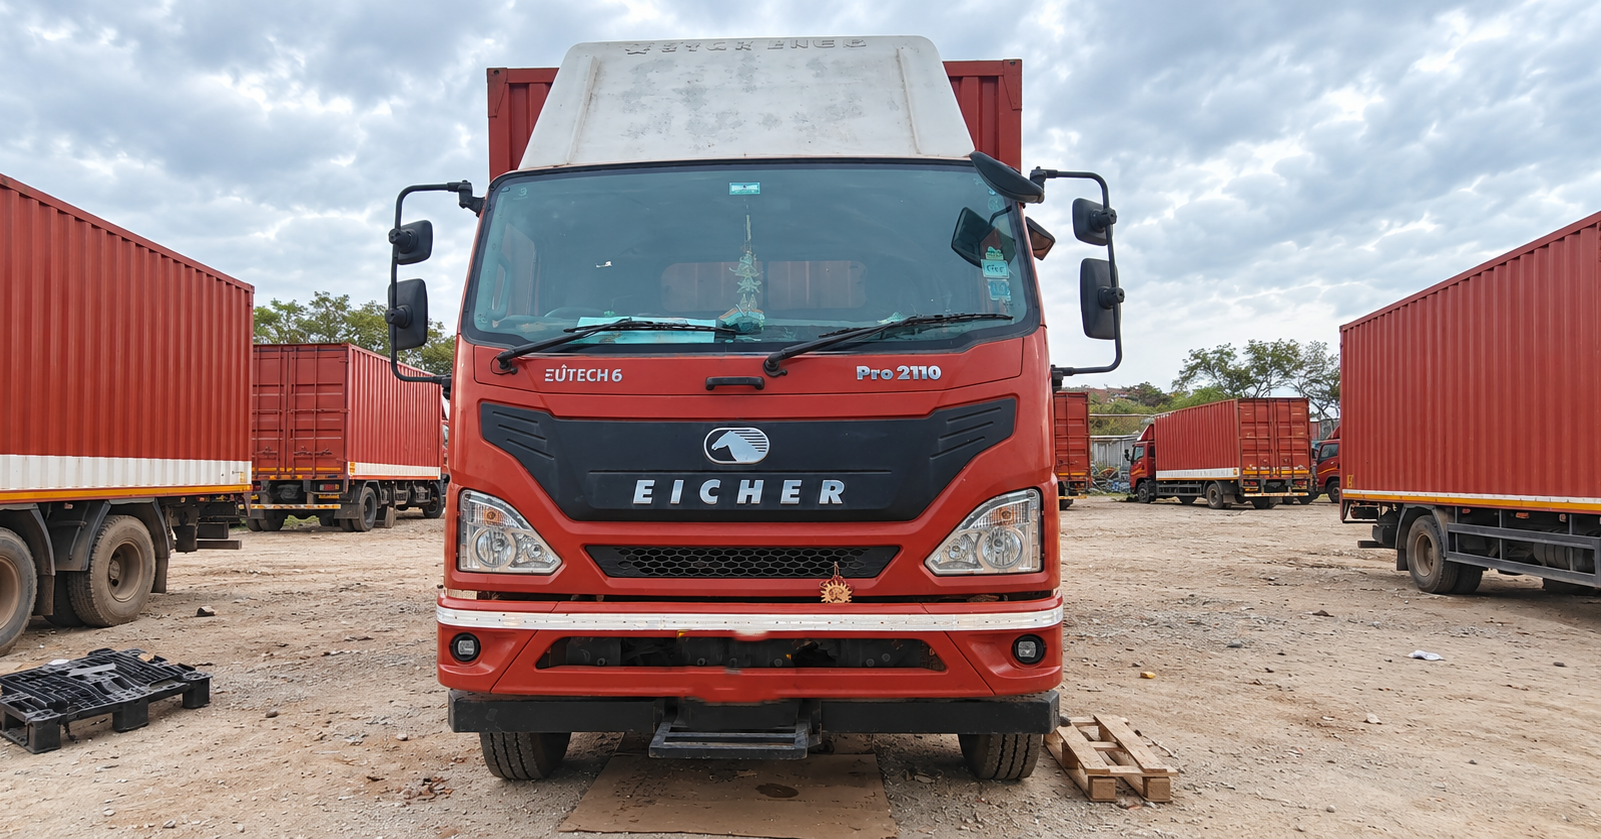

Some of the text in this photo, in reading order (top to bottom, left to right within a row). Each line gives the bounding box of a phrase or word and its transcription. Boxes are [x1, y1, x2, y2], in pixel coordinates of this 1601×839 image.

[856, 365, 942, 380] Pro 2110
[632, 479, 845, 505] EICHER
